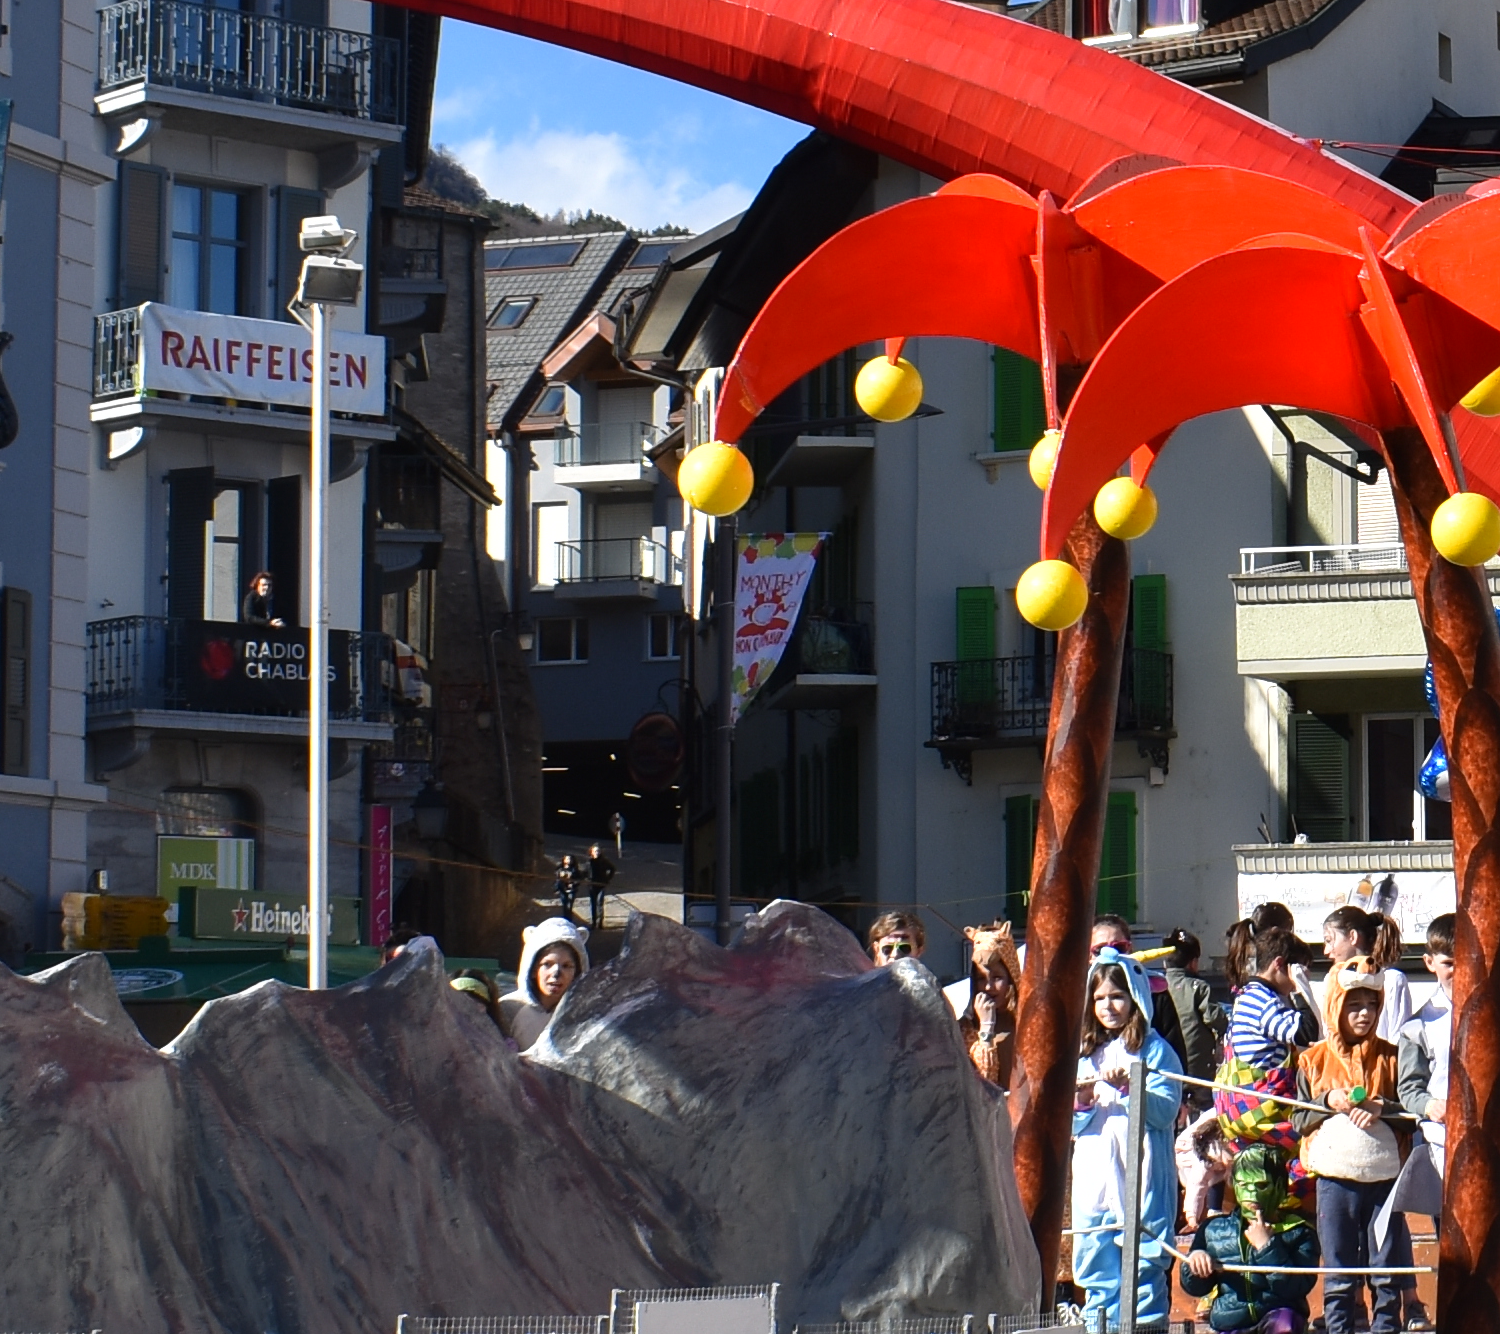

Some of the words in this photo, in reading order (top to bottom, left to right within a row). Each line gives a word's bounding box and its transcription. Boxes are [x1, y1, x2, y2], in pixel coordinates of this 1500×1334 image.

[245, 641, 306, 659] RADIO
[245, 662, 337, 682] CHABLS
[170, 862, 217, 881] MDK
